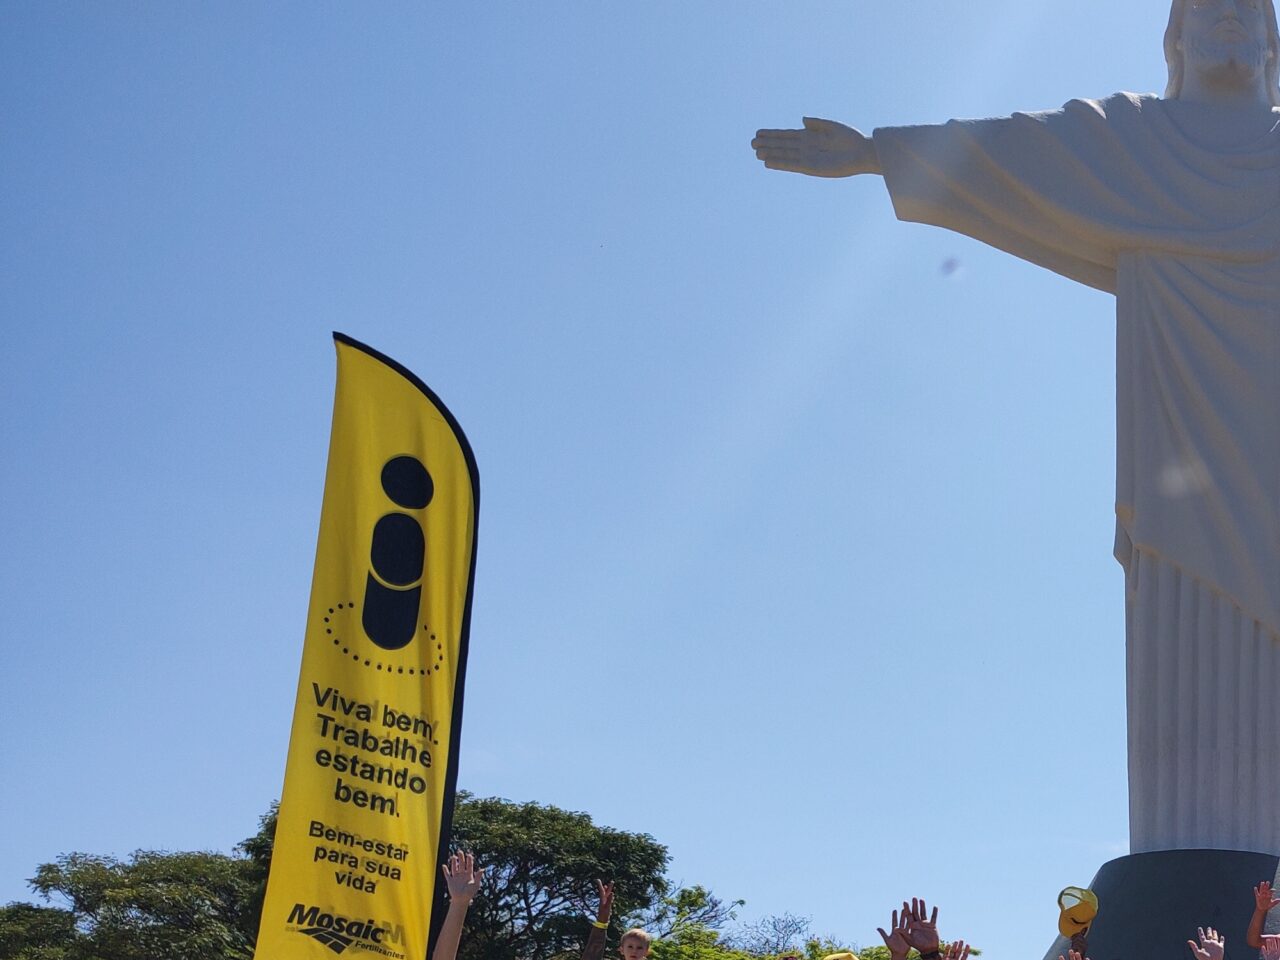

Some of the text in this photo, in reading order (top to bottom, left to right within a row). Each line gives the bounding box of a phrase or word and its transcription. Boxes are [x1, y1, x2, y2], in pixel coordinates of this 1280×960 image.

[312, 682, 440, 746] Viva bem.
[316, 713, 433, 768] Trabalhe
[315, 748, 427, 795] estando
[334, 778, 400, 818] bem.
[309, 820, 409, 862] Bem-estar
[314, 845, 402, 881] para sua
[335, 870, 376, 894] vida
[286, 903, 386, 944] Mosaic
[355, 940, 405, 960] Fertilizantes
